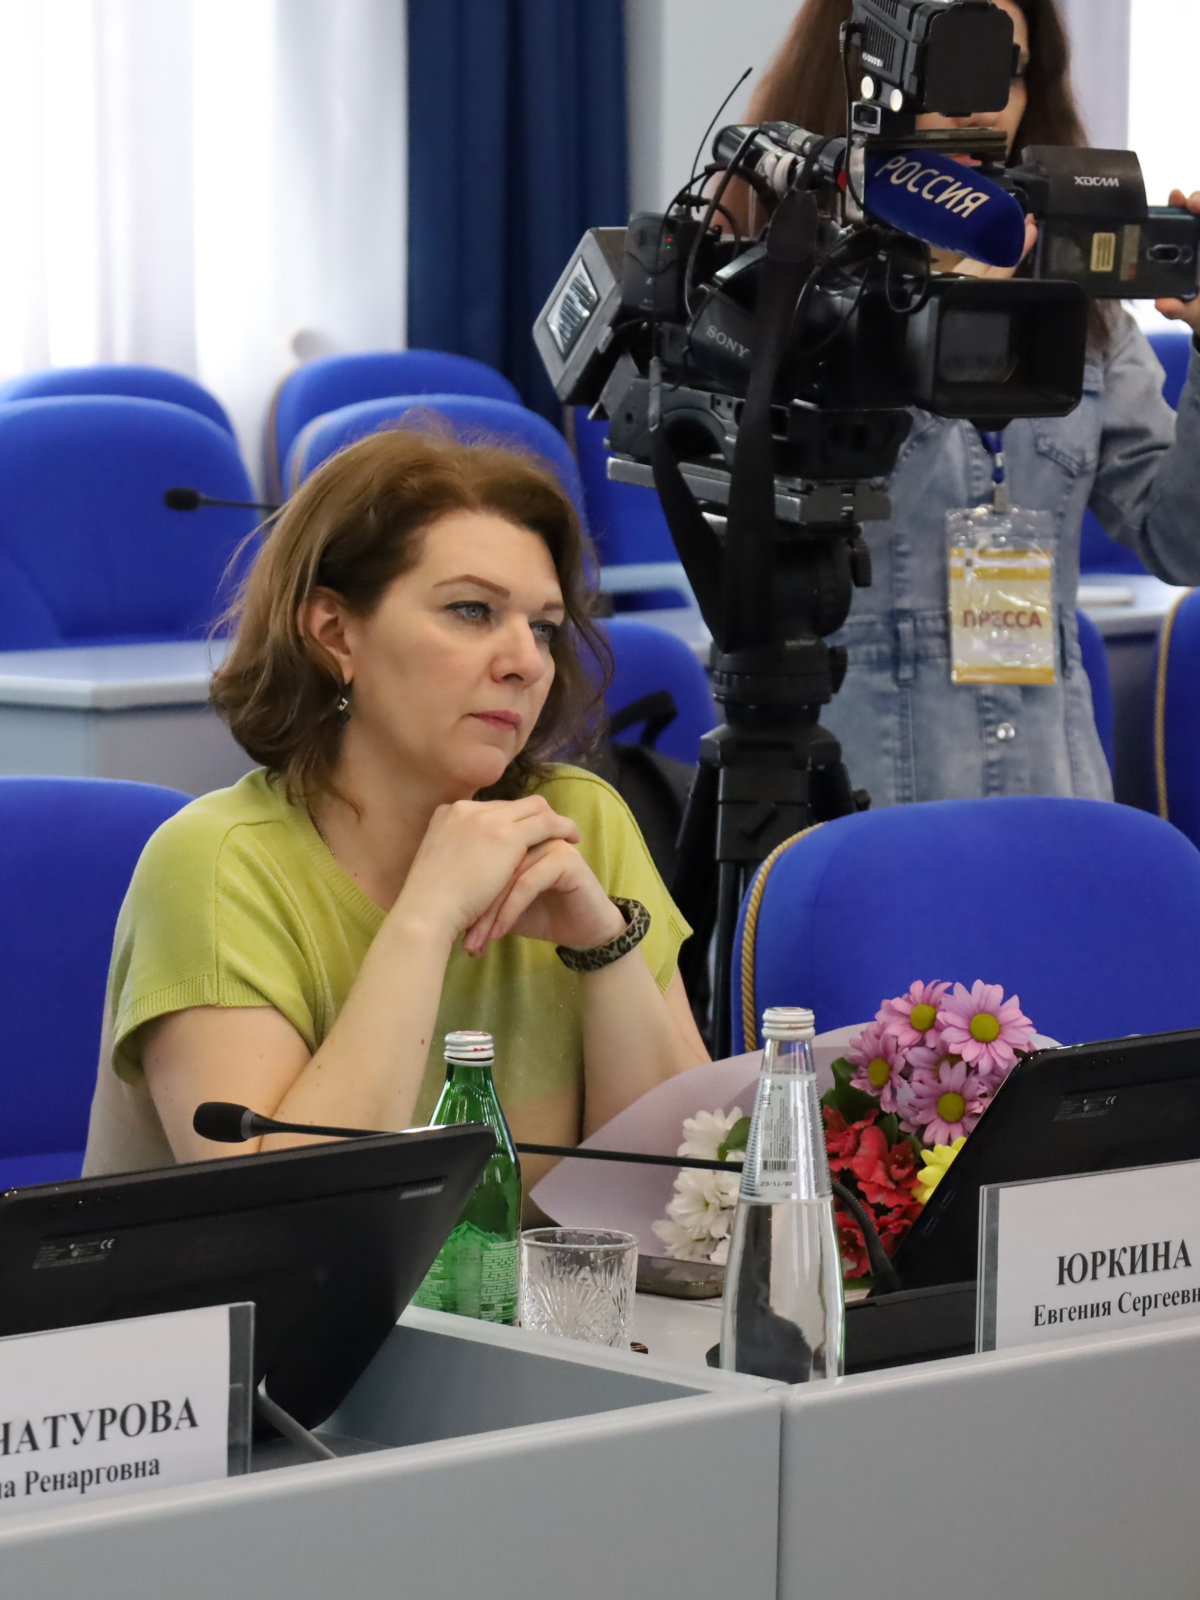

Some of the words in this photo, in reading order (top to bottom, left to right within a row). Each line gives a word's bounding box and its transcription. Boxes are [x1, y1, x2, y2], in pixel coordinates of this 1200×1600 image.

[874, 156, 990, 218] РОССИЯ
[1074, 176, 1119, 187] XDCAM
[706, 325, 751, 357] SONY
[963, 610, 1043, 628] ПРЕССА
[1056, 1238, 1192, 1285] ЮРКИНА
[1033, 1301, 1112, 1327] Евгения
[24, 1458, 160, 1496] Ренарговна
